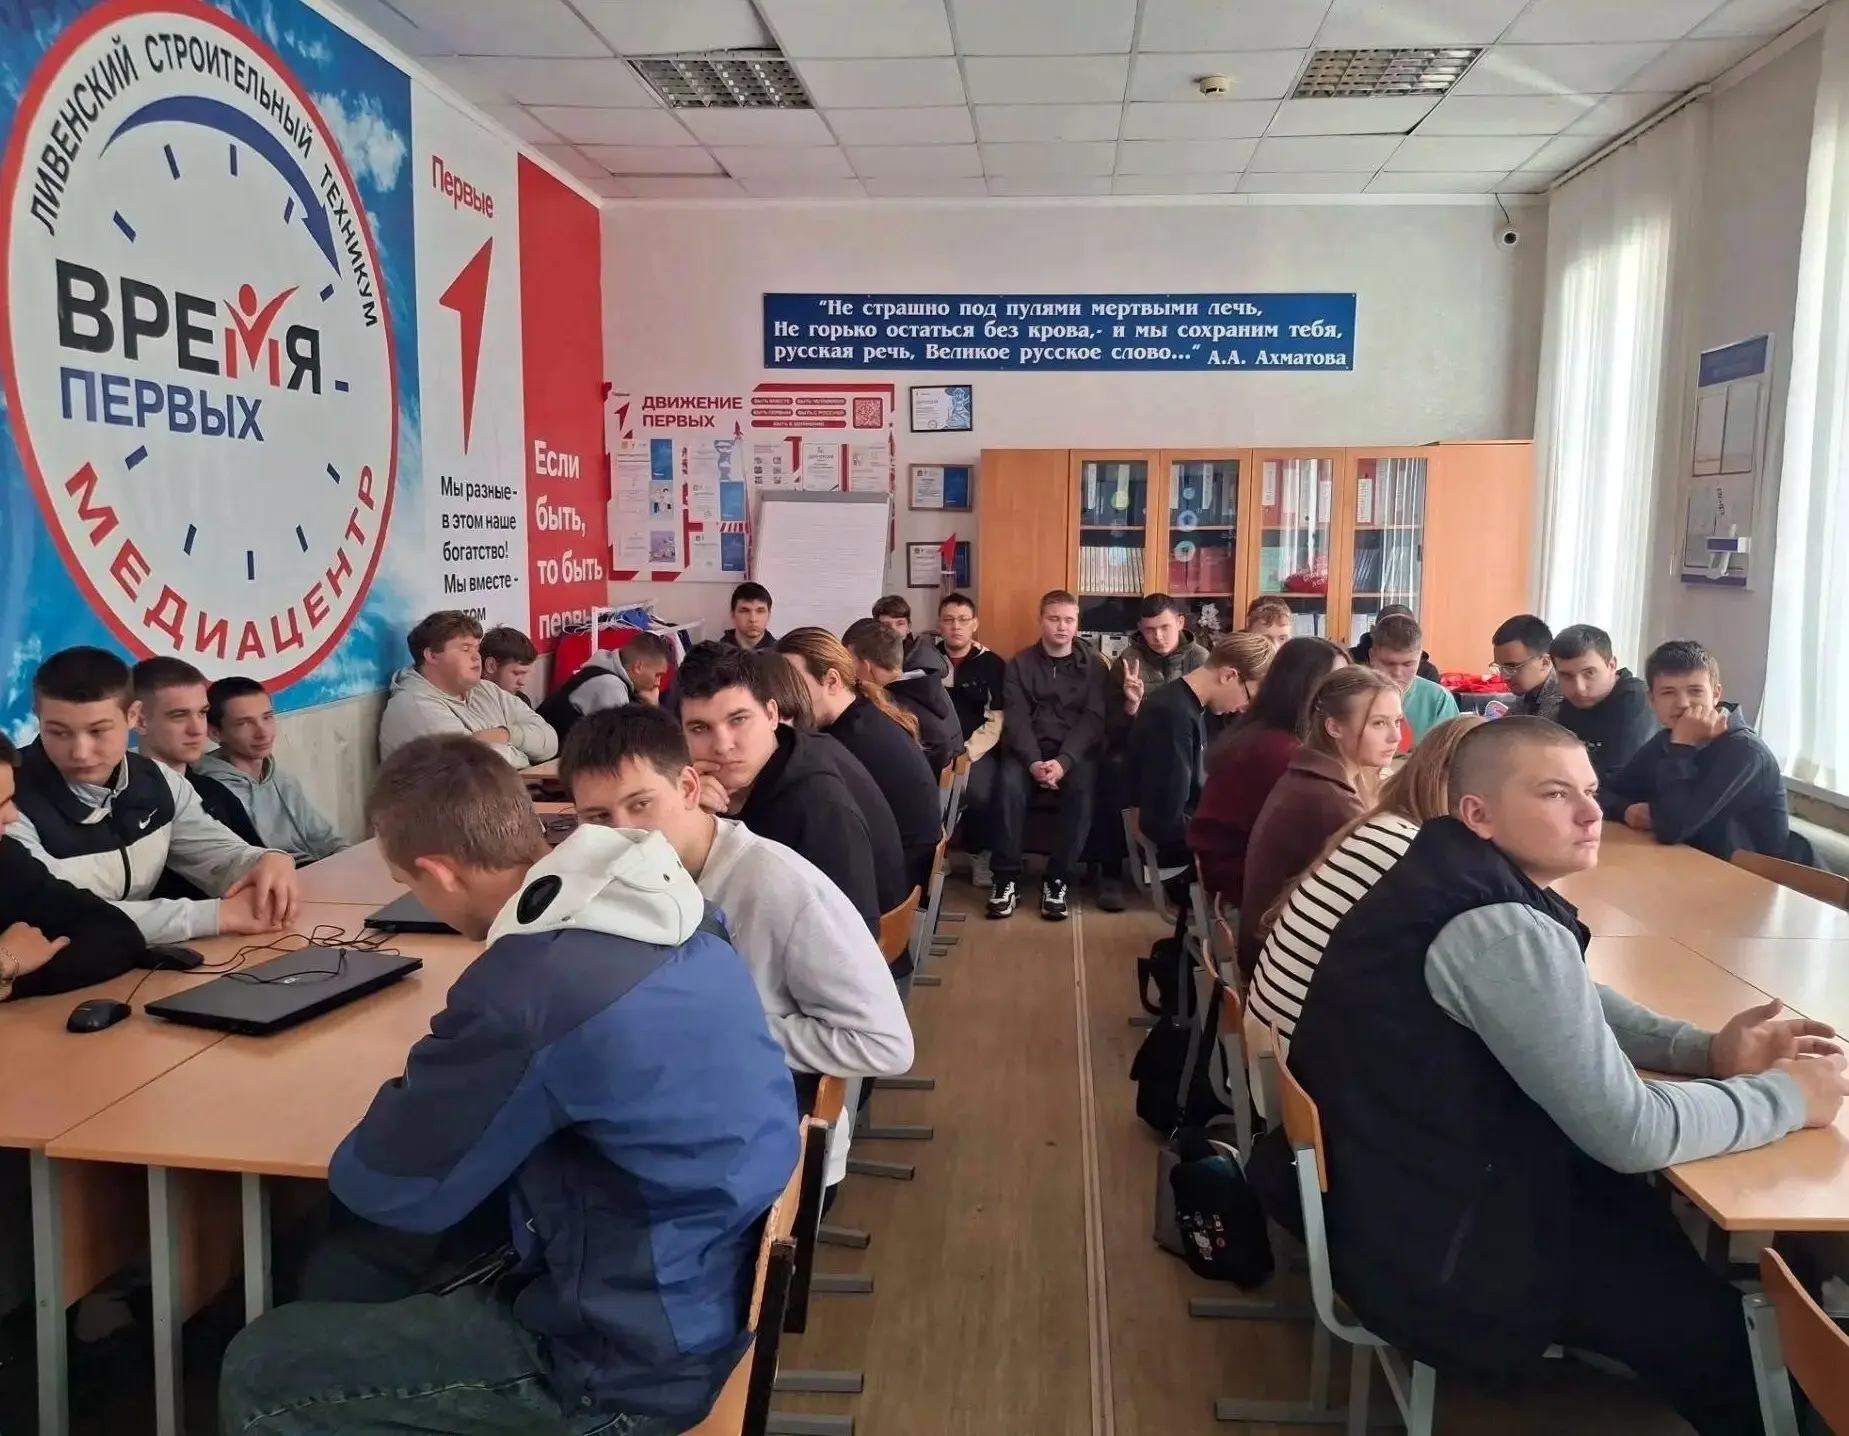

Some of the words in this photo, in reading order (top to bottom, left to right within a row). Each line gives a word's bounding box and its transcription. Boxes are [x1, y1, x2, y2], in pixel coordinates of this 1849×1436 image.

[30, 35, 140, 237] ЛИВЕНСКИЙ
[144, 33, 314, 159] СТРОИТЕЛЬНЫЙ
[319, 163, 378, 328] ТЕХНИКУМ
[432, 155, 494, 218] Первые
[862, 303, 950, 320] страшно
[959, 303, 997, 319] под
[1006, 303, 1081, 319] пулями
[1091, 303, 1199, 320] мертвыми
[1208, 302, 1263, 316] лечь,
[55, 258, 322, 395] ВРЕМЯ
[774, 321, 800, 337] Не
[809, 324, 877, 341] горько
[886, 324, 975, 338] остаться
[984, 320, 1019, 337] без
[1028, 324, 1102, 341] крова,-
[1112, 325, 1125, 338] и
[1135, 325, 1167, 338] мы
[1177, 324, 1279, 341] сохраним
[1289, 319, 1342, 339] тебя,
[774, 345, 853, 362] русская
[863, 345, 915, 362] речь,
[926, 343, 1010, 360] Великое
[1020, 345, 1101, 363] русское
[1207, 350, 1246, 365] А.А.
[1255, 350, 1347, 366] Ахматова
[60, 366, 264, 442] ПЕРВЫХ
[642, 395, 743, 411] ДВИЖЕНИЕ
[643, 414, 715, 428] ПЕРВЫХ
[534, 440, 580, 479] Если
[441, 475, 464, 497] Мы
[442, 514, 450, 529] в
[453, 514, 483, 529] этом
[486, 515, 517, 530] наше
[535, 495, 586, 537] быть,
[64, 461, 375, 661] МЕДИАЦЕНТР
[443, 541, 509, 561] богатство!
[537, 559, 558, 585] то
[562, 550, 603, 583] быть
[444, 574, 467, 594] Мы
[469, 574, 511, 592] вместе
